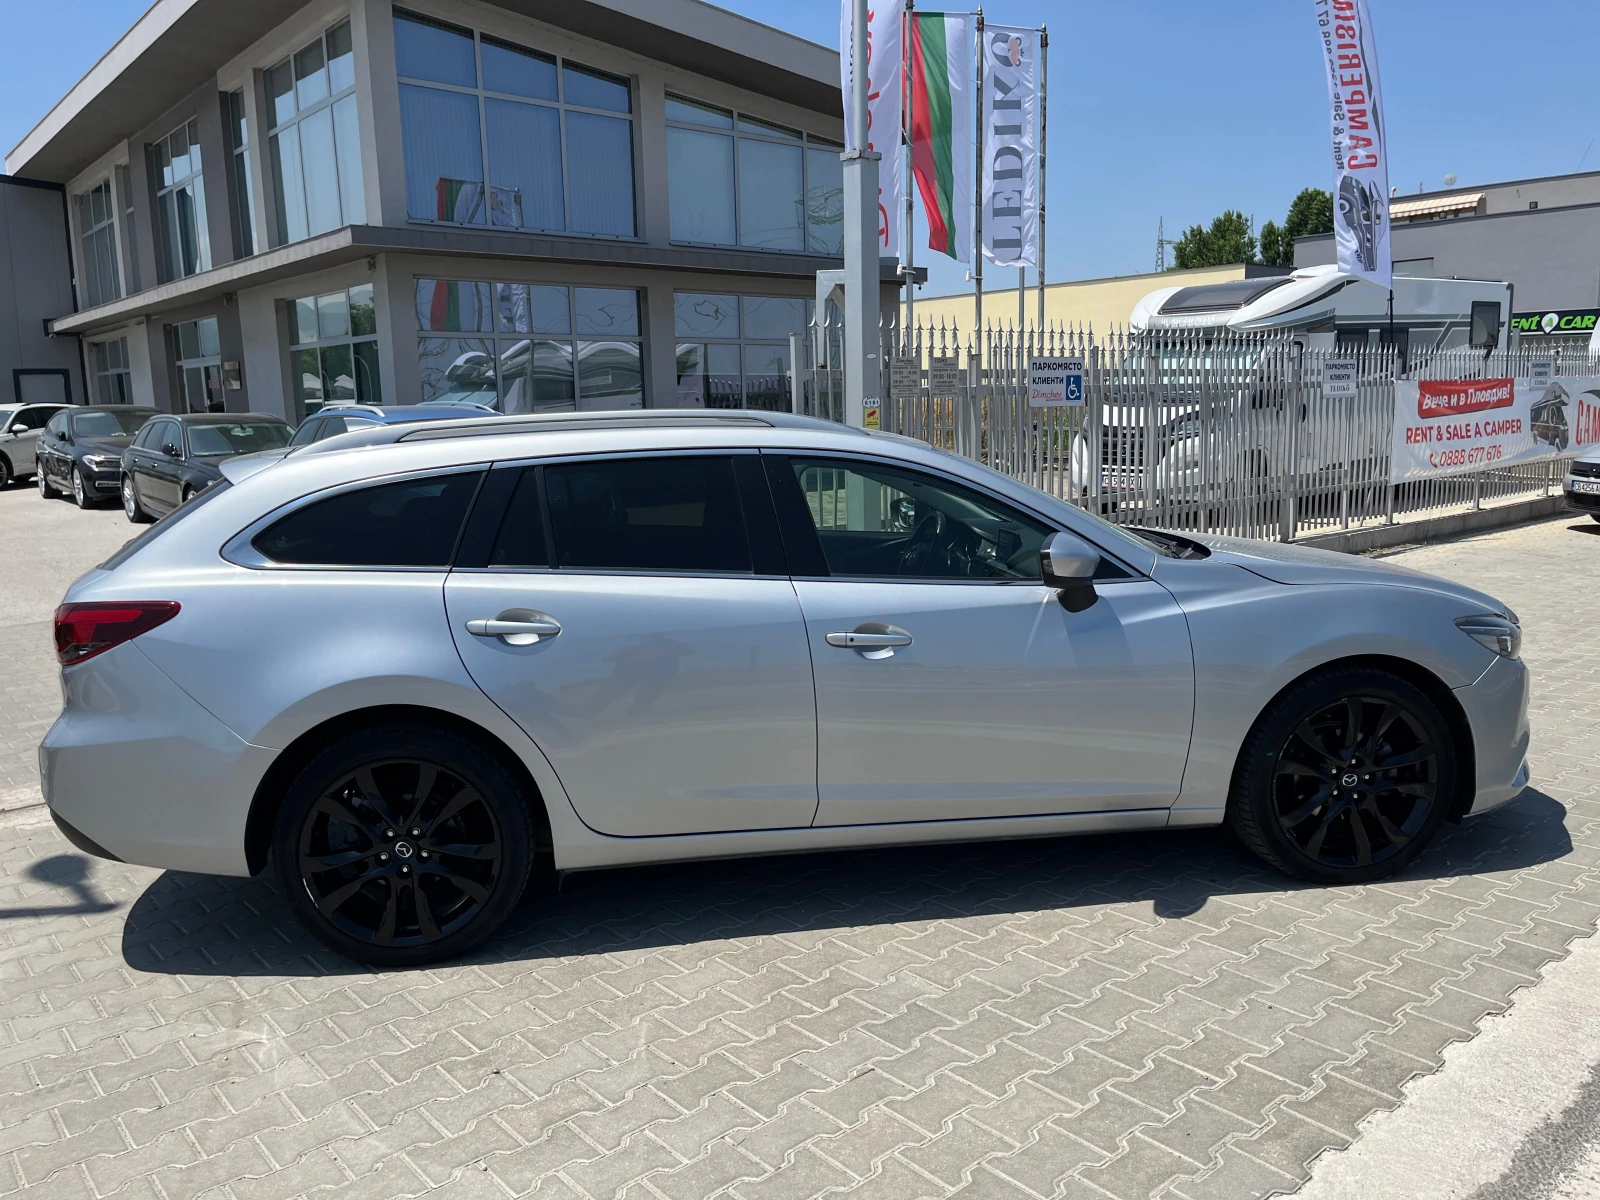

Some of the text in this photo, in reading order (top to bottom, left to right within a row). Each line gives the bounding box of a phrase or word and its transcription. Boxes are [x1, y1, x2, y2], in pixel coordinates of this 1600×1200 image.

[1560, 315, 1596, 329] CAR
[1032, 362, 1082, 371] ПАРКОМЯСТО
[1032, 377, 1064, 385] КЛИЕНТИ
[1422, 393, 1449, 410] Вече
[1450, 394, 1458, 407] и
[1467, 383, 1511, 404] Пловдив!
[1405, 419, 1522, 444] RENT & SALE A CAMPER
[1440, 444, 1502, 466] 0888 677 676
